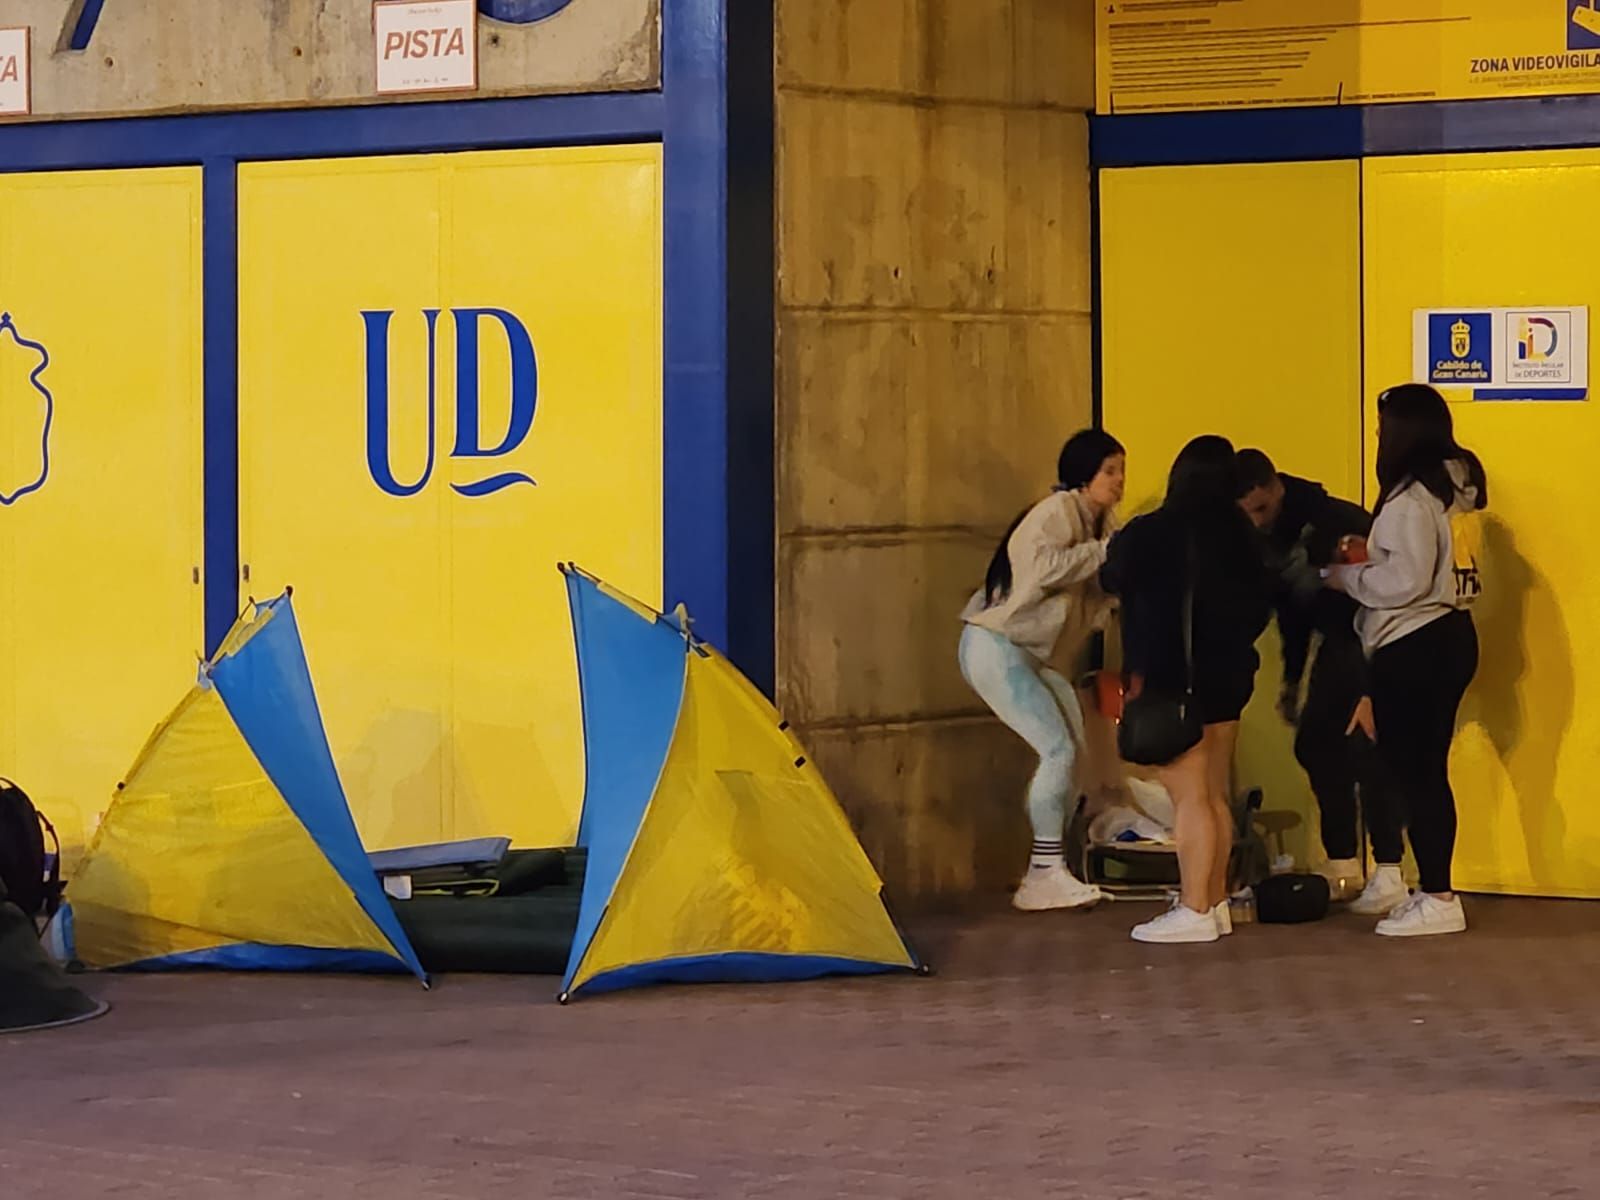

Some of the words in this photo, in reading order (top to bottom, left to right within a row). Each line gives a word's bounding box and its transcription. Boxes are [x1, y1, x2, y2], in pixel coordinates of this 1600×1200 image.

[383, 27, 465, 60] PISTA
[0, 56, 18, 82] A
[1471, 58, 1509, 73] ZONA
[359, 308, 538, 497] UD
